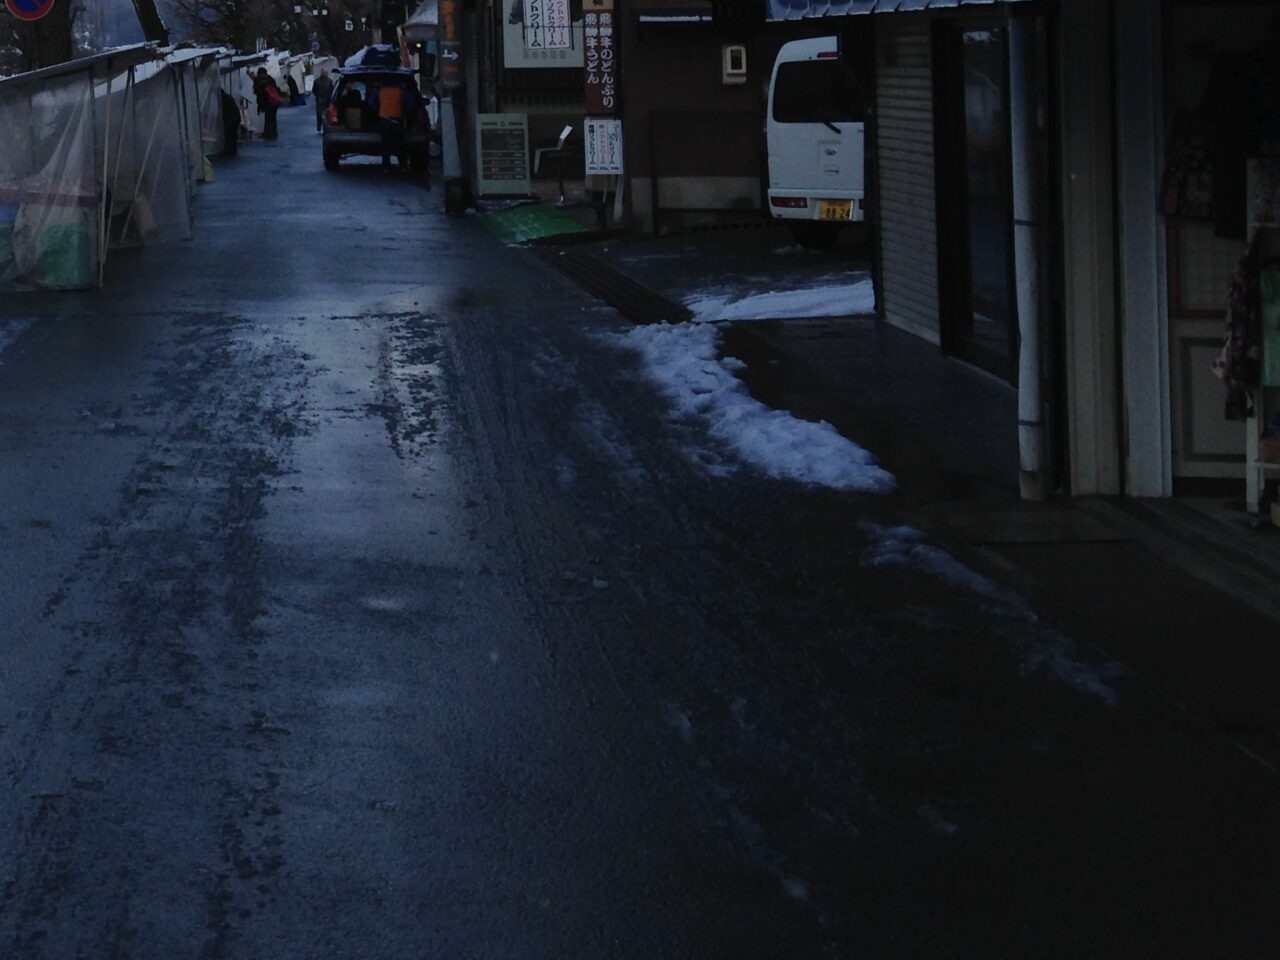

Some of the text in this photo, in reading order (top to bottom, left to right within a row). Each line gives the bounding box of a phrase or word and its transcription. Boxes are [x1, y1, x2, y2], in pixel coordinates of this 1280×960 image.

[585, 13, 599, 84] 飛騨牛うどん
[599, 12, 614, 108] 飛騨牛のどんぶり
